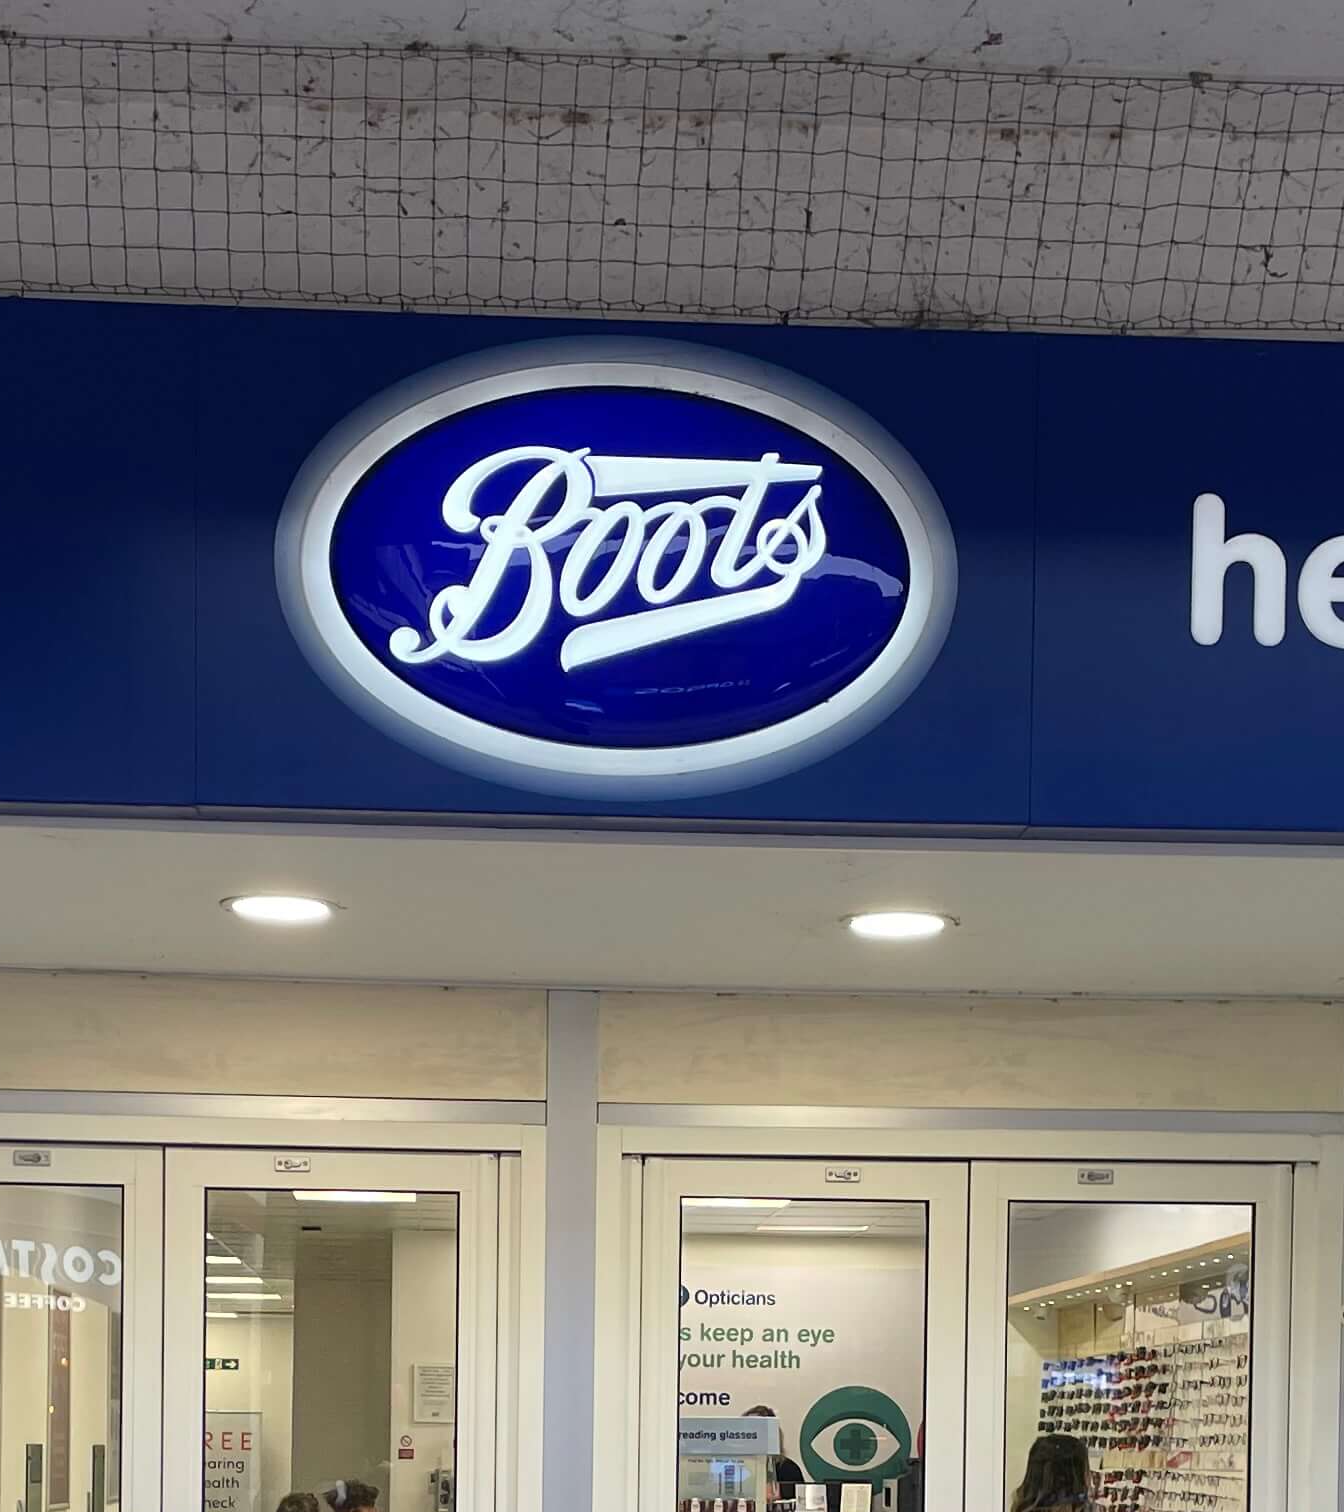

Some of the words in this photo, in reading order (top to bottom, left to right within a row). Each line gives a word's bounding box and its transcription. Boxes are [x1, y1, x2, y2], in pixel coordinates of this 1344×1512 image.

[389, 445, 827, 672] Boots
[694, 1289, 776, 1308] Opticians
[700, 1323, 754, 1345] keep
[761, 1327, 789, 1343] an
[797, 1327, 835, 1347] eye
[731, 1350, 801, 1369] health
[719, 1430, 758, 1442] glasses
[207, 1457, 245, 1473] aring
